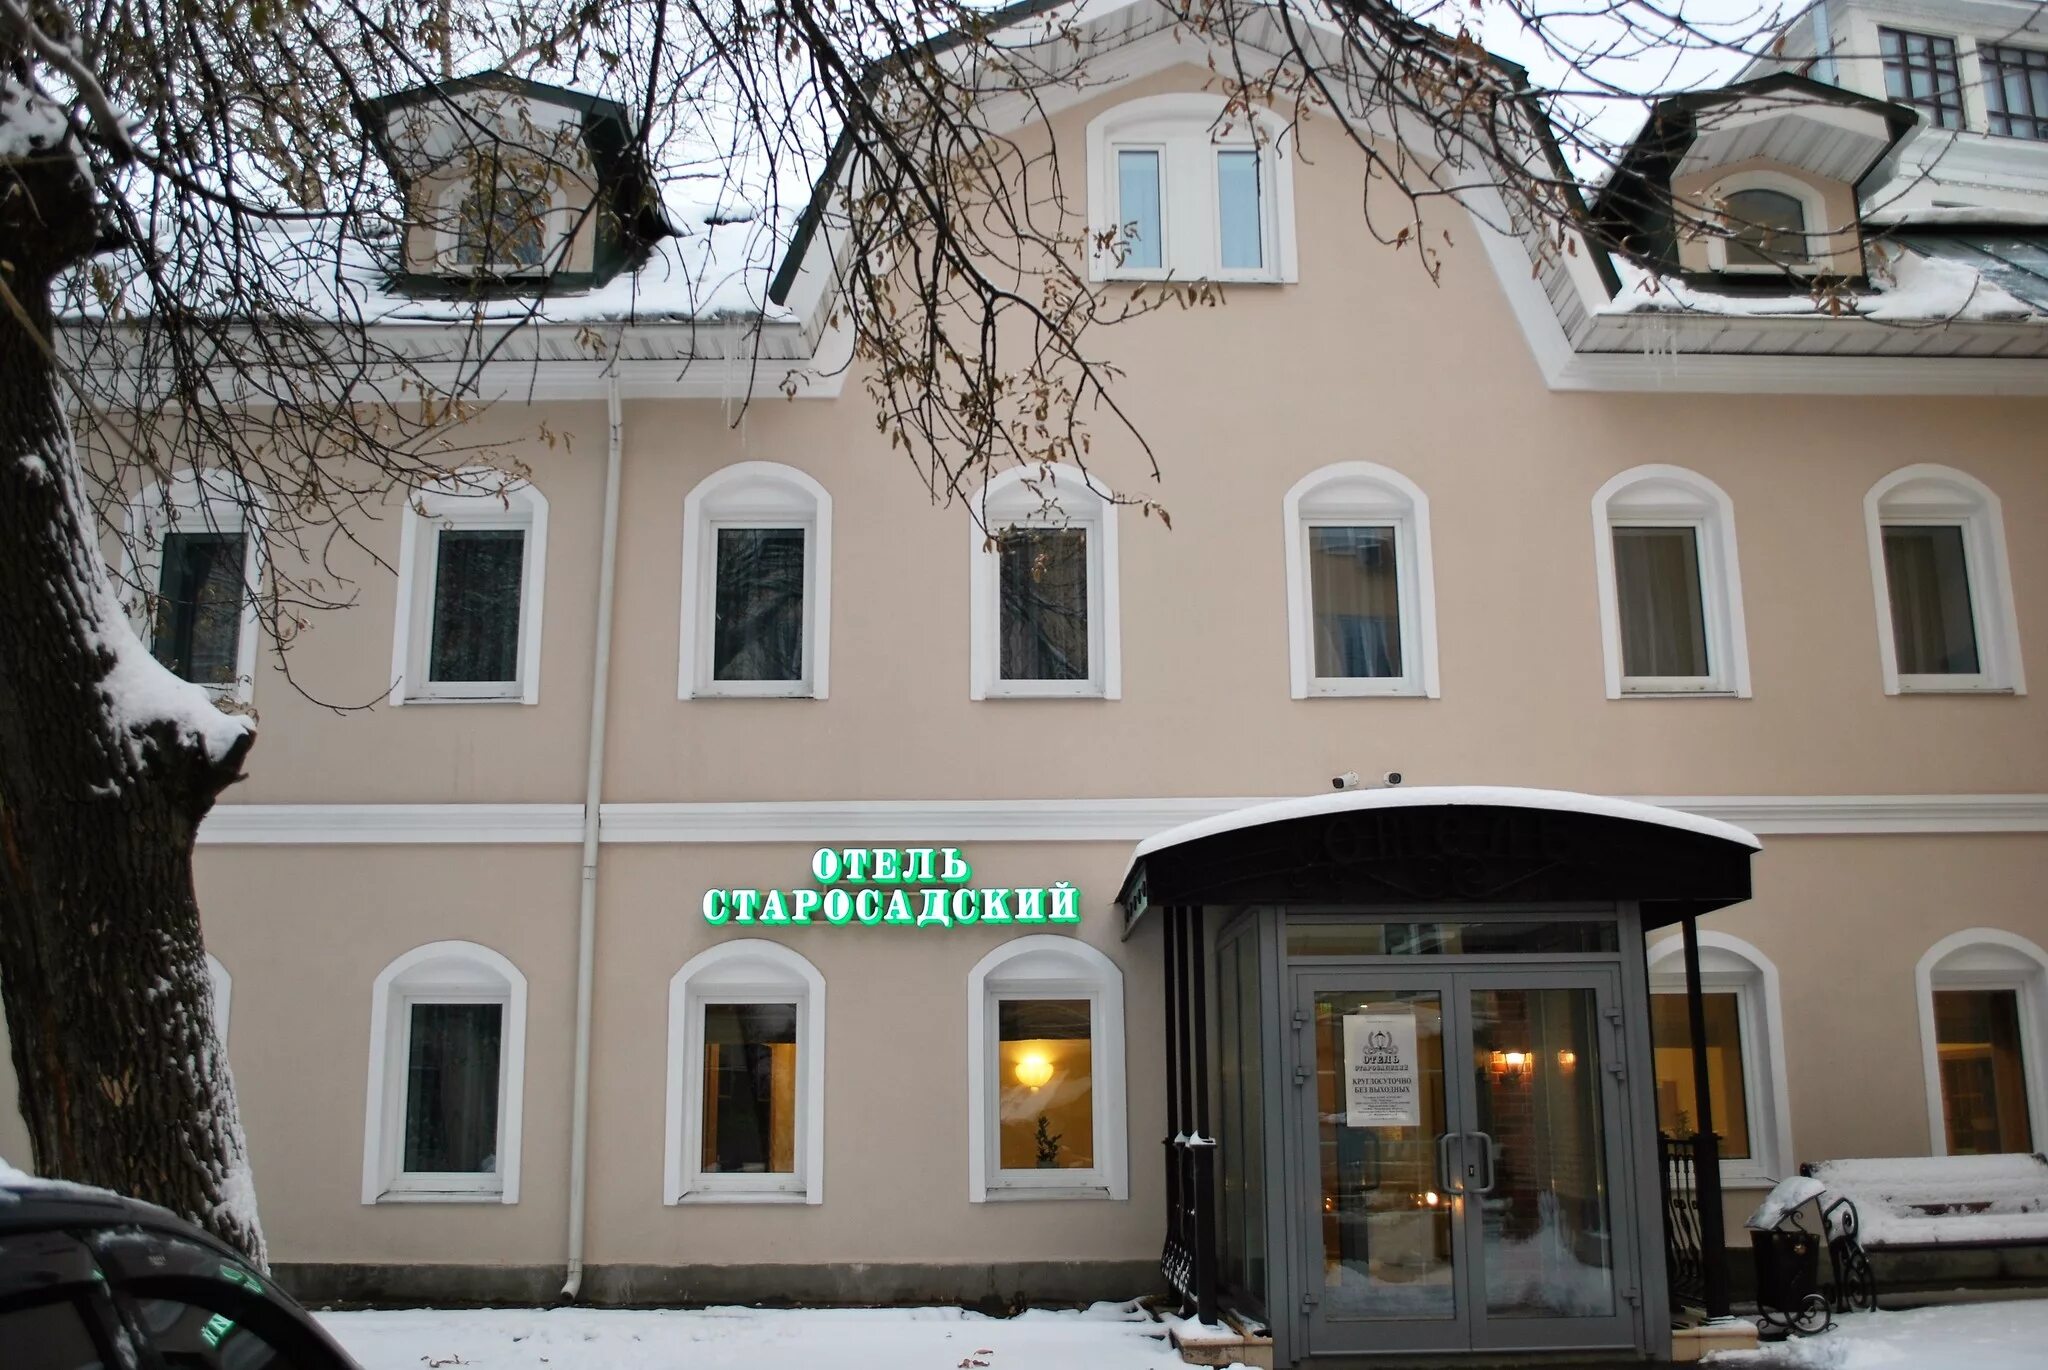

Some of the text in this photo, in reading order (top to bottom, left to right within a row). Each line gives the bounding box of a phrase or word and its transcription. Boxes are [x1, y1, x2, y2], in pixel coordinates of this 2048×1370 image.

[812, 847, 973, 884] ОТЕЛЬ
[702, 881, 1081, 928] СТАРОСАДСКИЙ
[1352, 1078, 1412, 1086] КРУГЛОСУТОЧНО
[1354, 1085, 1410, 1094] БЕЗ ВЫХОДНЫХ
